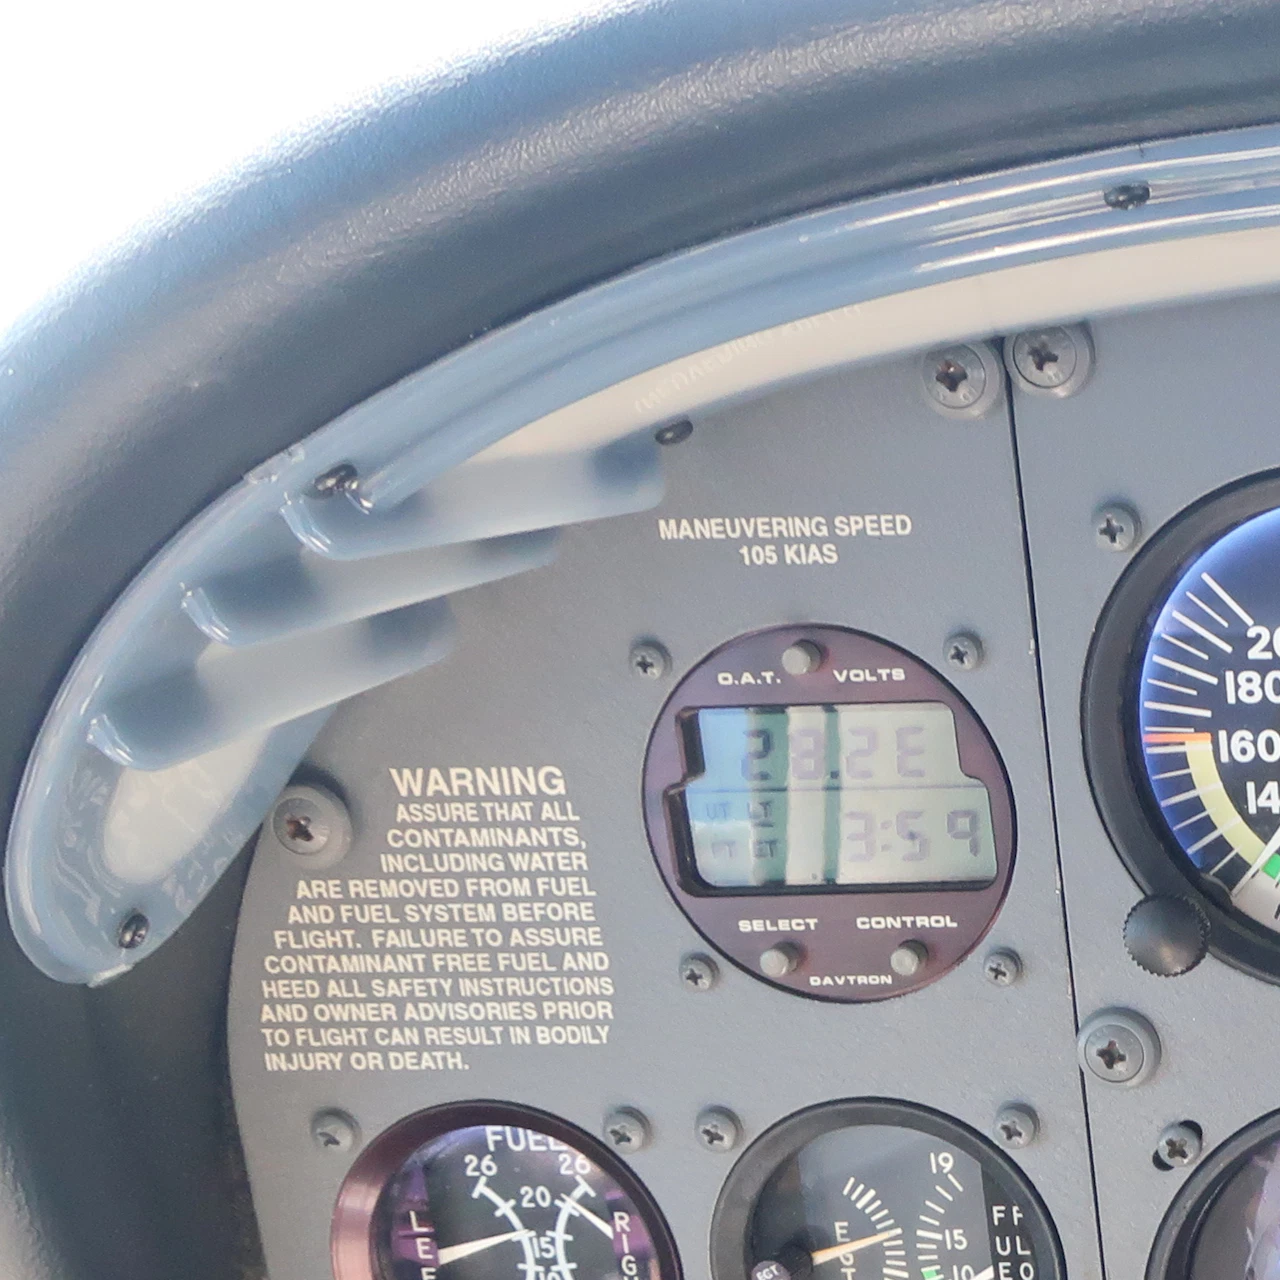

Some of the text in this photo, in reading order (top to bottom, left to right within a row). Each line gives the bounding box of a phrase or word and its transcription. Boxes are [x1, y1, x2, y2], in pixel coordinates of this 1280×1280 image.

[659, 515, 911, 540] MANEUVERING SPEED
[739, 544, 838, 565] 105 KIAS
[718, 671, 780, 685] O.A.T.
[833, 668, 905, 682] VOLTS
[390, 766, 565, 796] WARNING
[397, 801, 580, 823] ASSURE THAT ALL
[388, 827, 586, 849] CONTAMINANTS,
[381, 852, 588, 872] INCLUDING WATER
[739, 919, 818, 932] SELECT
[857, 916, 957, 929] CONTROL
[810, 975, 892, 986] DAVTRON
[265, 1051, 469, 1071] INJURY OR DEATH.
